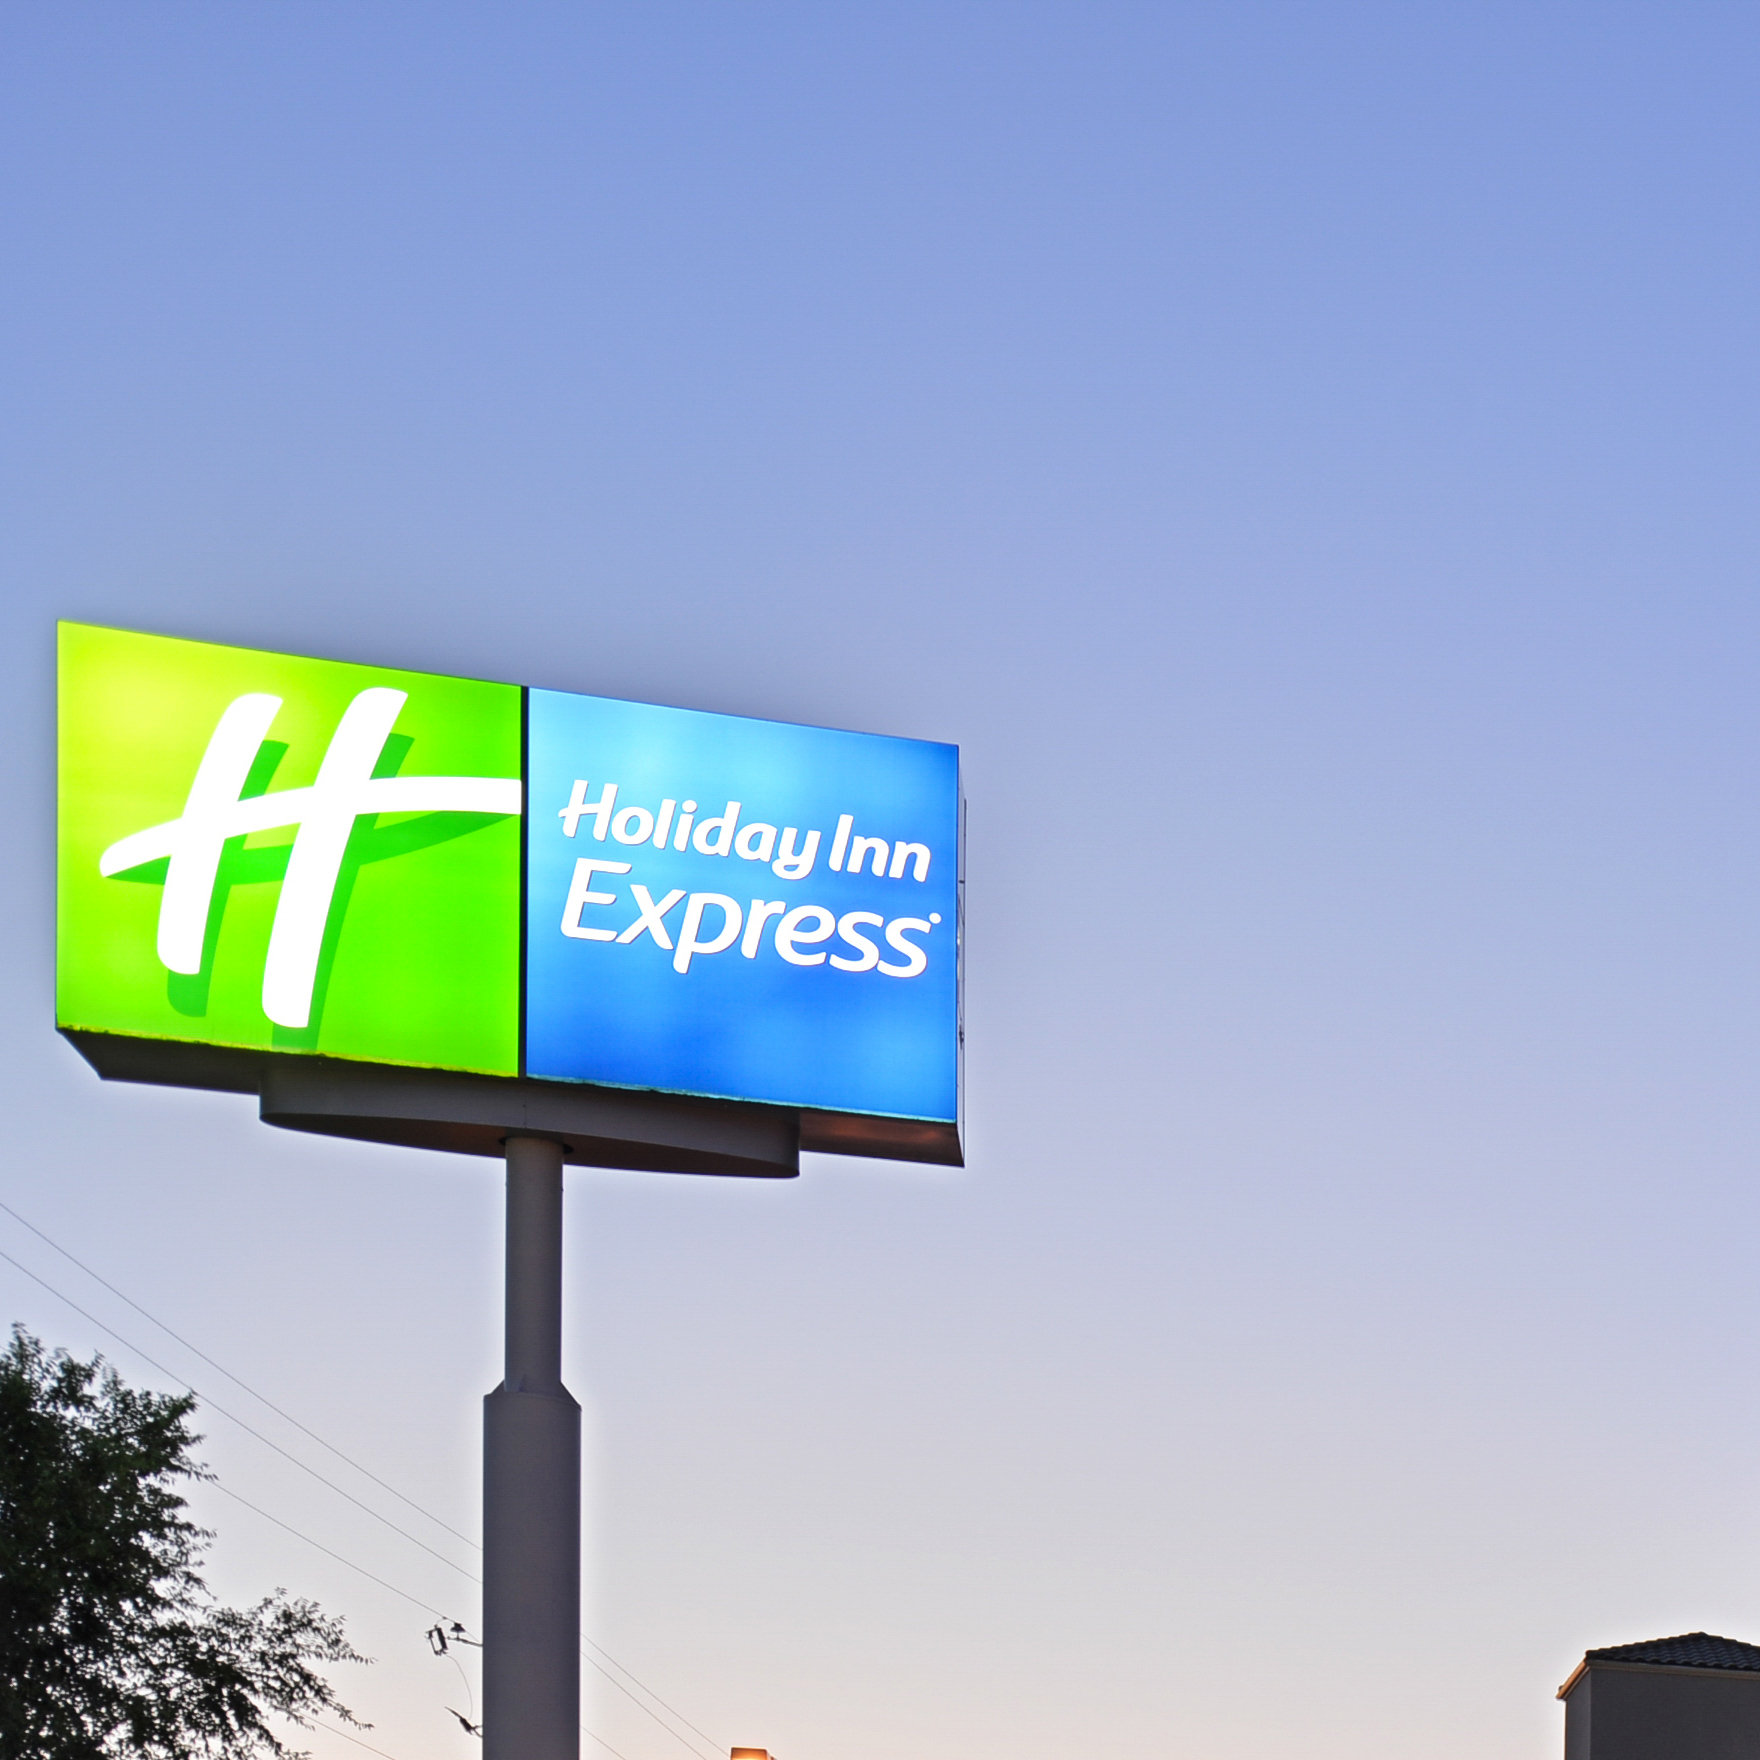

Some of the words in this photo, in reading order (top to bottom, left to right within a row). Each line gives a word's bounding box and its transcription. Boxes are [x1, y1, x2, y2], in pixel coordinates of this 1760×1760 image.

[558, 779, 822, 880] Holiday
[828, 813, 932, 882] Inn
[560, 857, 930, 978] Express
